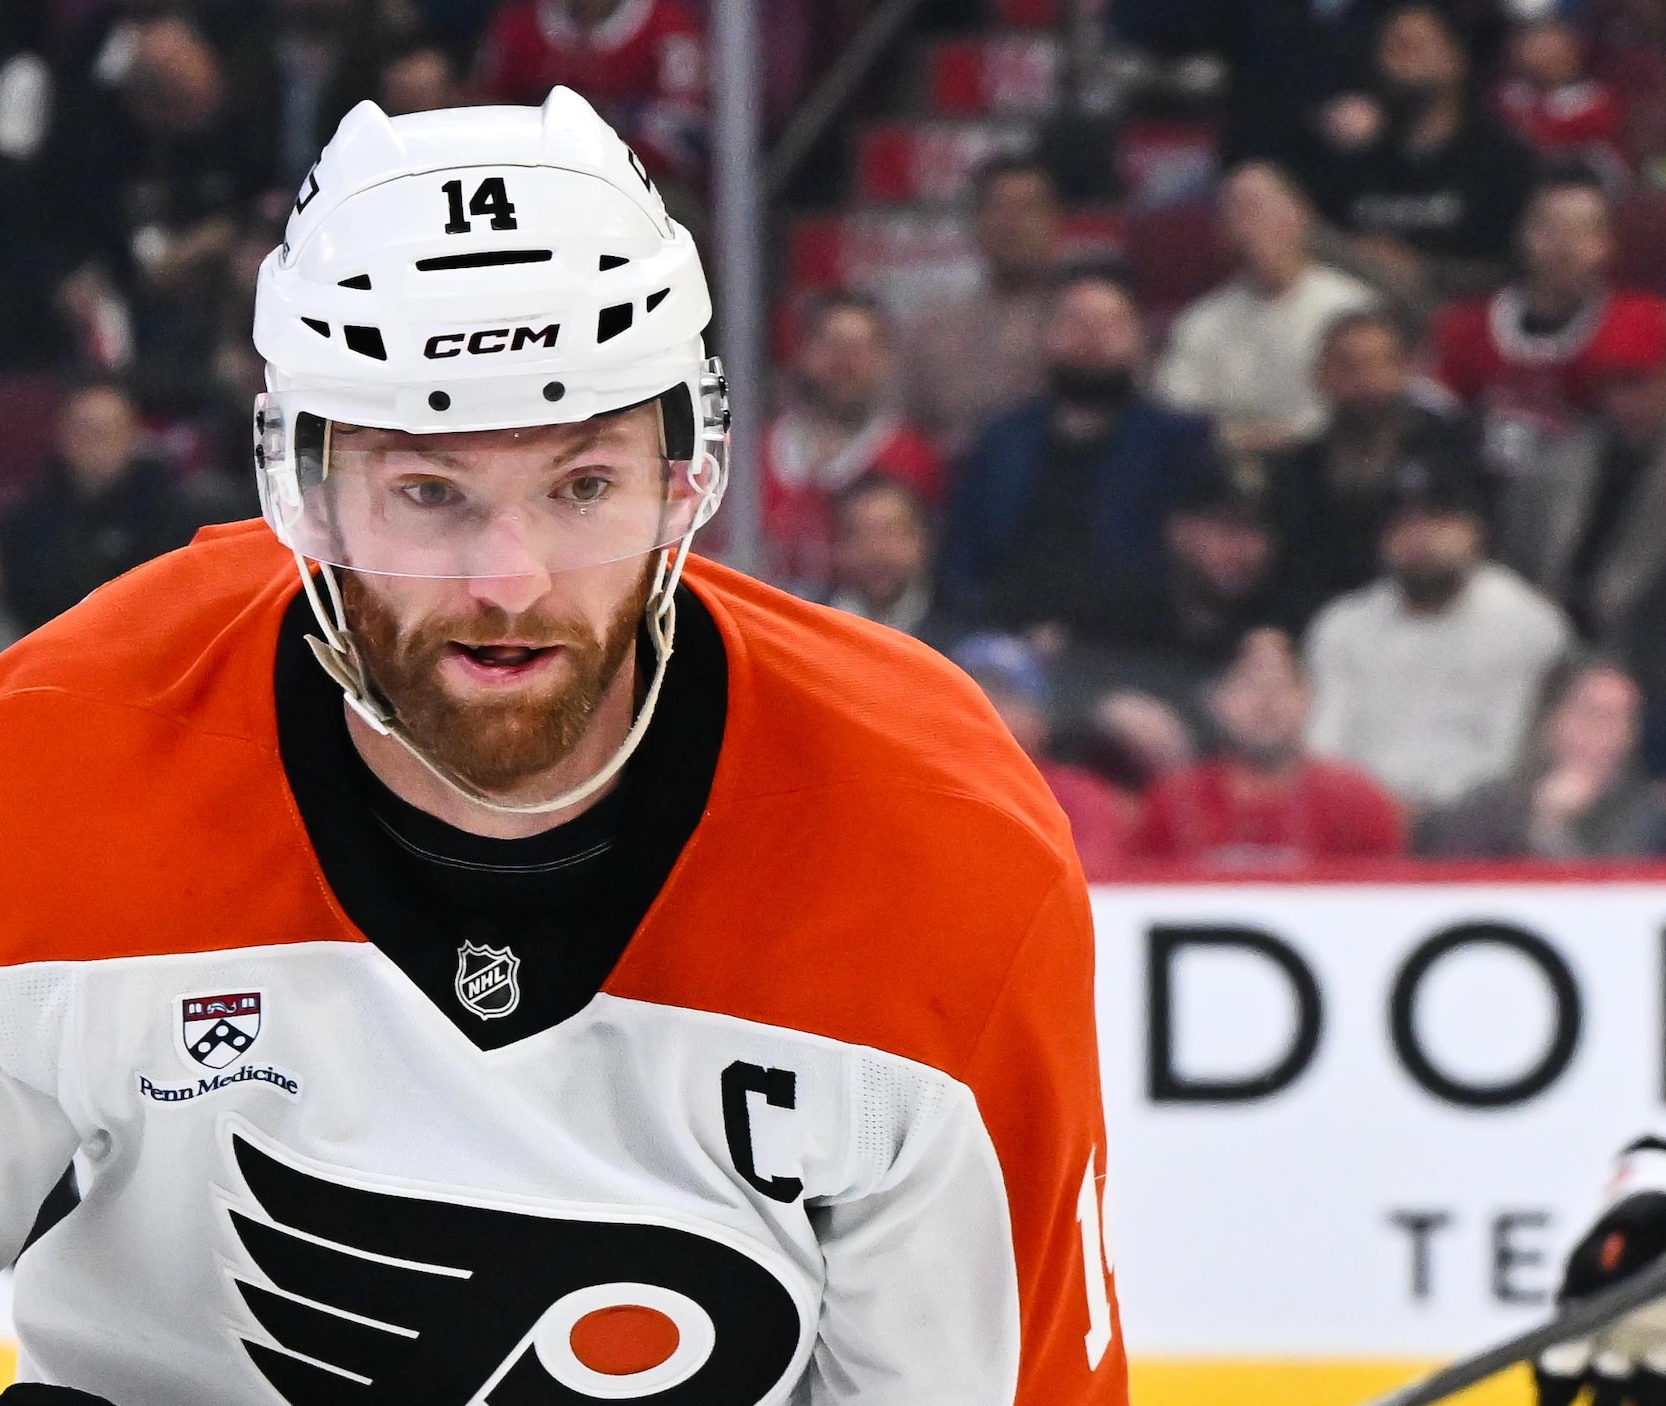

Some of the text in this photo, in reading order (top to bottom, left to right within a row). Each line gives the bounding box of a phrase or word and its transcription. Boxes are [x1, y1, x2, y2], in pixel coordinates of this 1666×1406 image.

[442, 177, 518, 234] 14
[423, 323, 561, 360] CCM
[468, 966, 506, 999] NHL
[139, 1065, 299, 1102] Penn Medicine
[721, 1060, 804, 1204] C
[1076, 1143, 1117, 1372] 1
